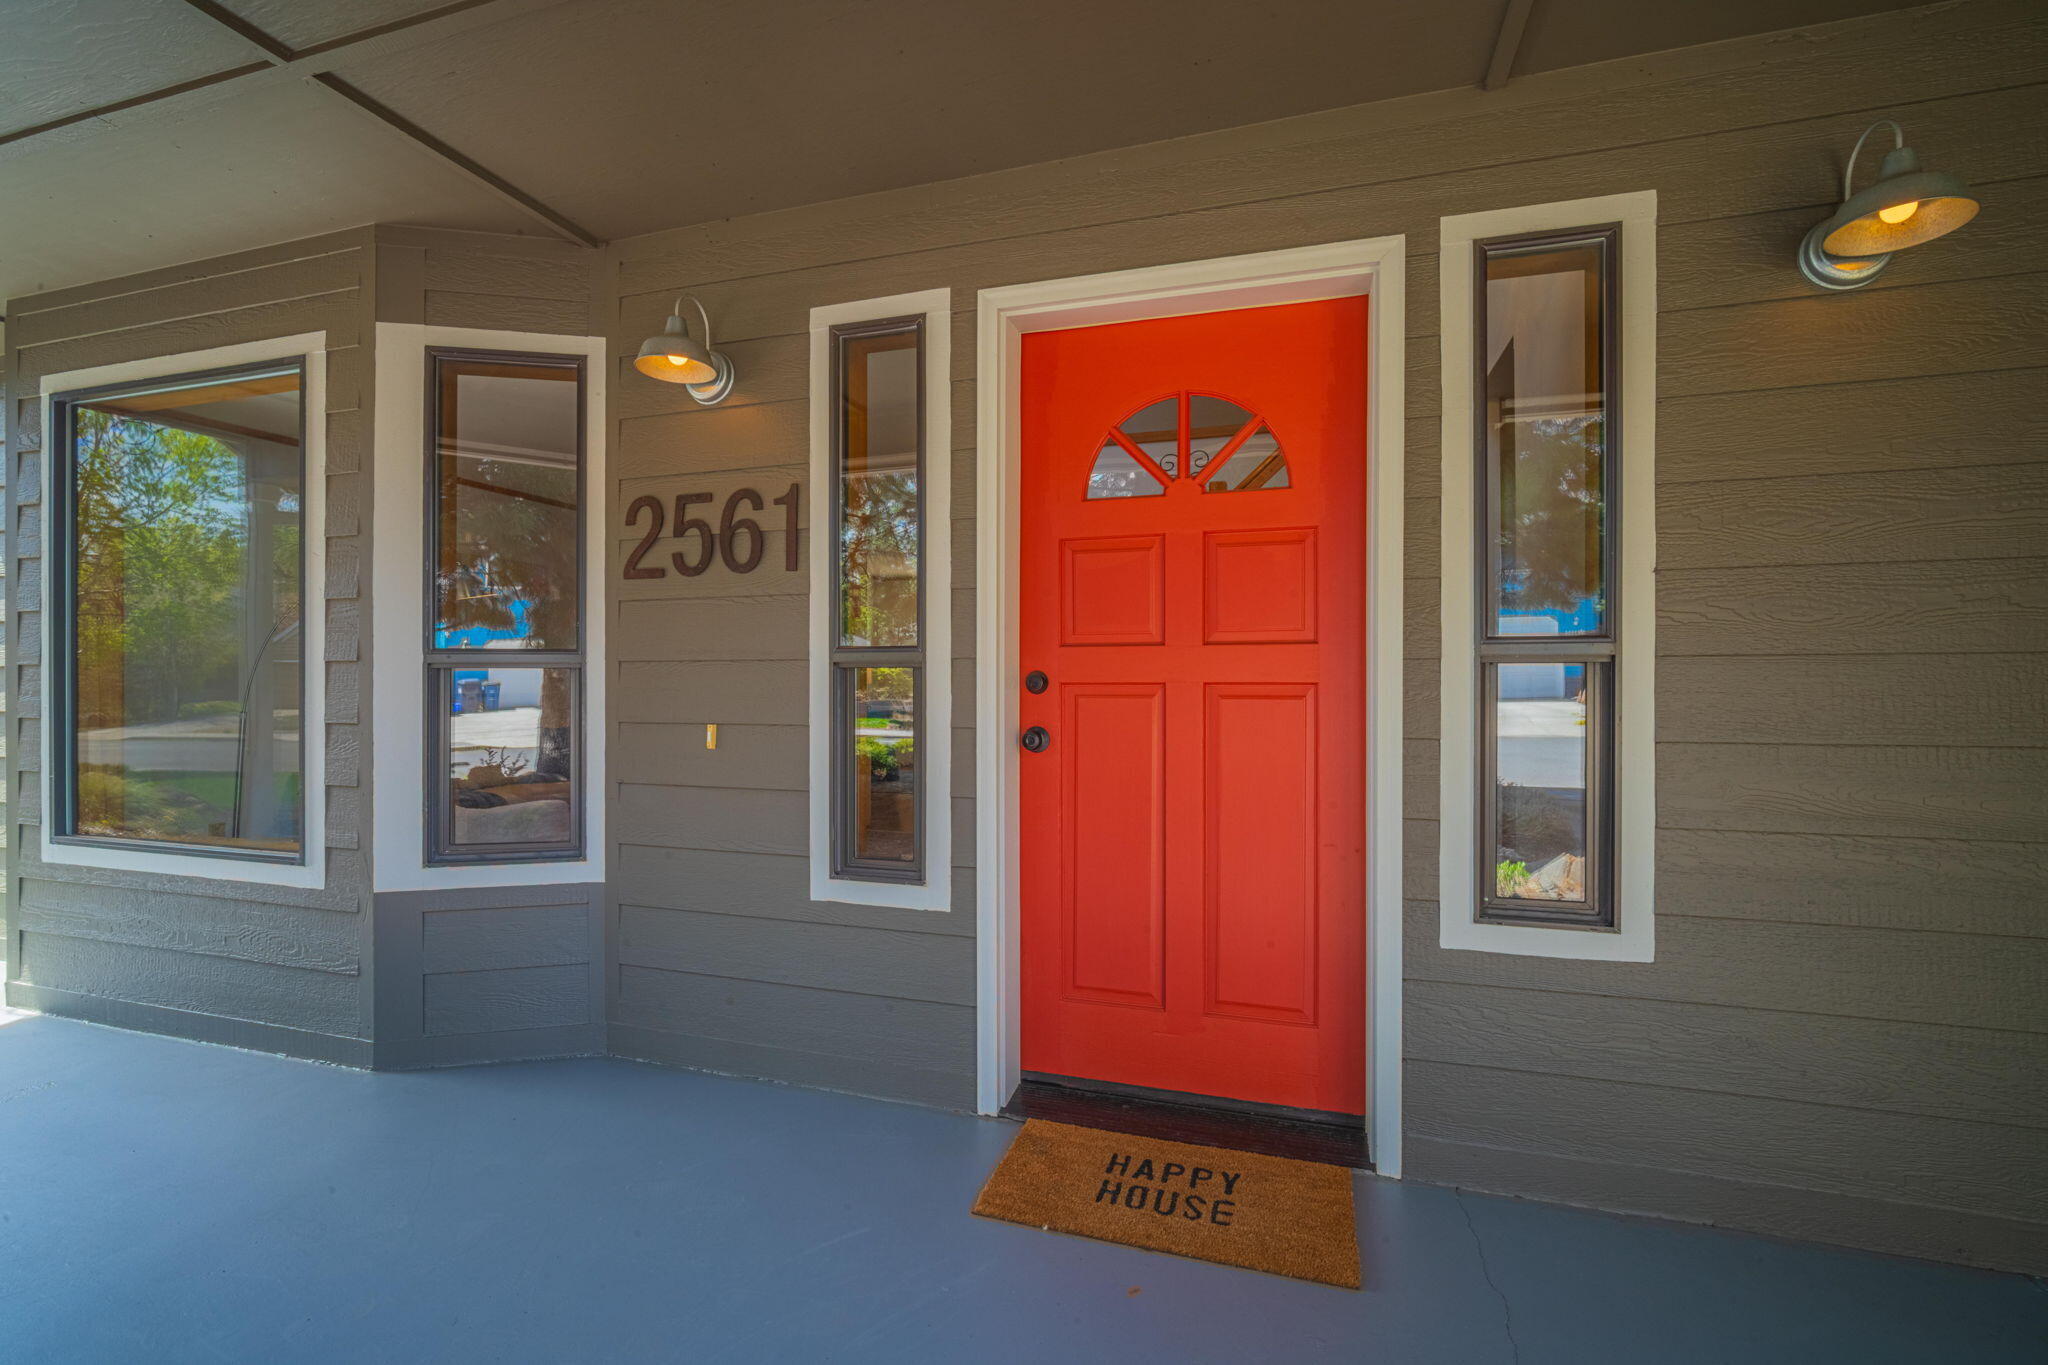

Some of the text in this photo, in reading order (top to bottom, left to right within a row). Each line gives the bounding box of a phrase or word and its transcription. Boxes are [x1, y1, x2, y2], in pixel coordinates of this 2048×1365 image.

[623, 482, 799, 580] 2561
[1104, 1153, 1241, 1195] HAPPY
[1095, 1179, 1236, 1226] HOUSE
